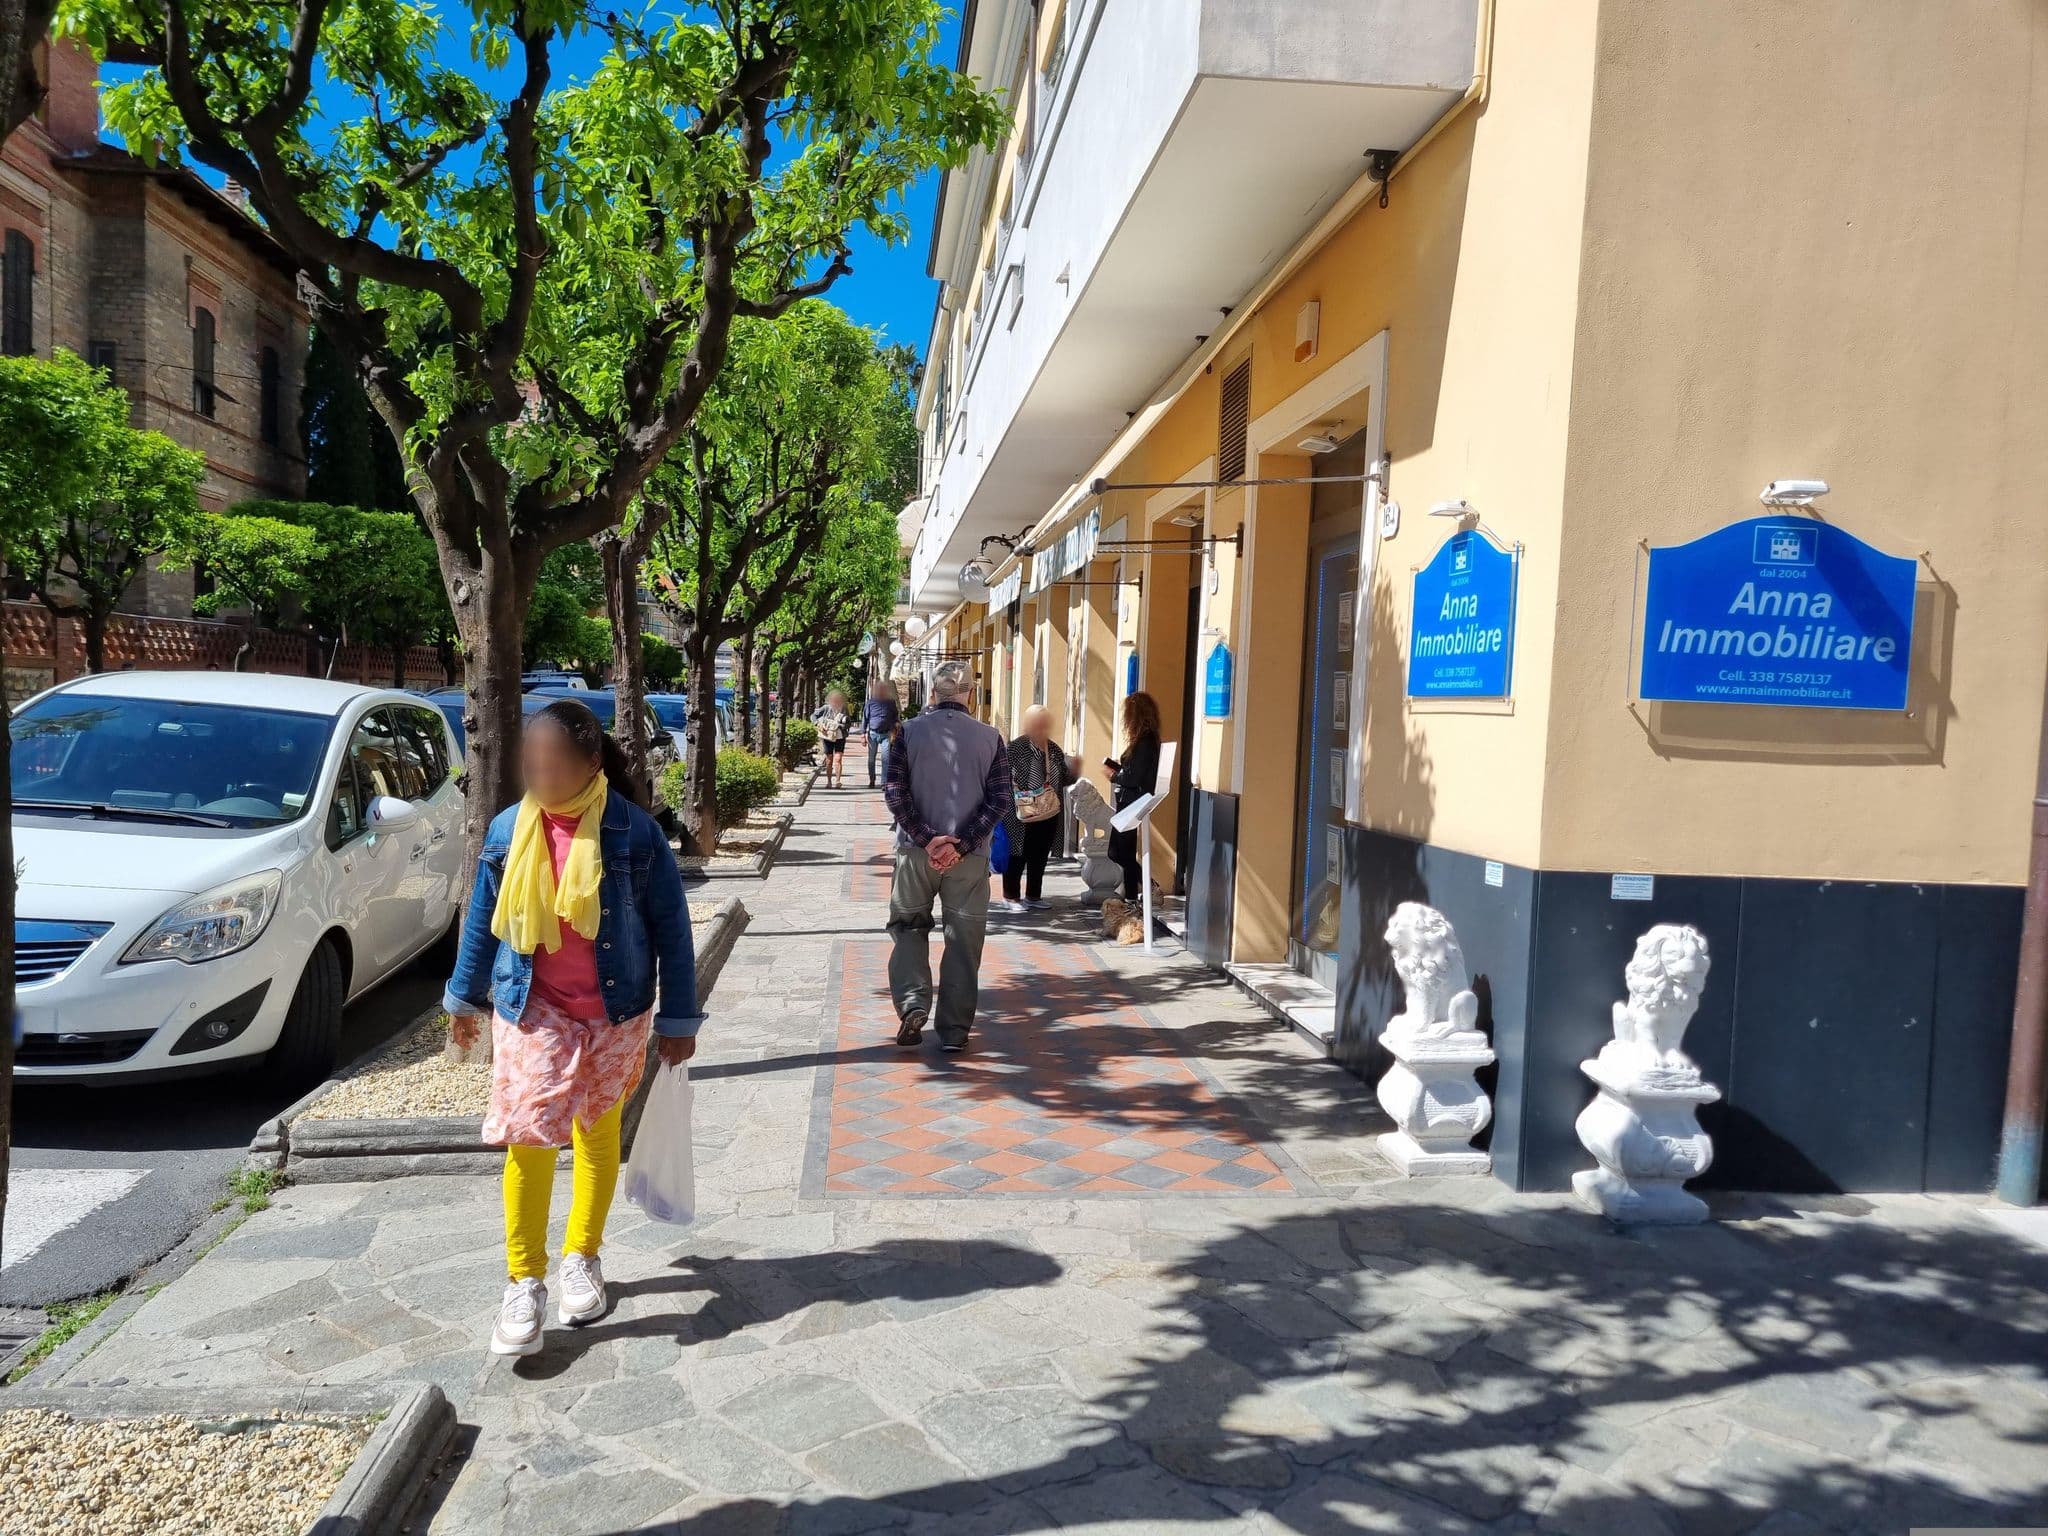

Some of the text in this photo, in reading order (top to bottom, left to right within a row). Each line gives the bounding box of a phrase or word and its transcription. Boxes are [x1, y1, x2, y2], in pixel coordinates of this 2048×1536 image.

[1759, 567, 1807, 579] dal 2004
[1440, 592, 1478, 621] Anna
[1728, 582, 1832, 618] Anna
[1415, 623, 1502, 657] Immobiliare
[1658, 620, 1896, 663] Immobiliare
[1695, 684, 1853, 699] www.annaimmobiliare.it
[1718, 669, 1832, 685] Cell. 338 7587137
